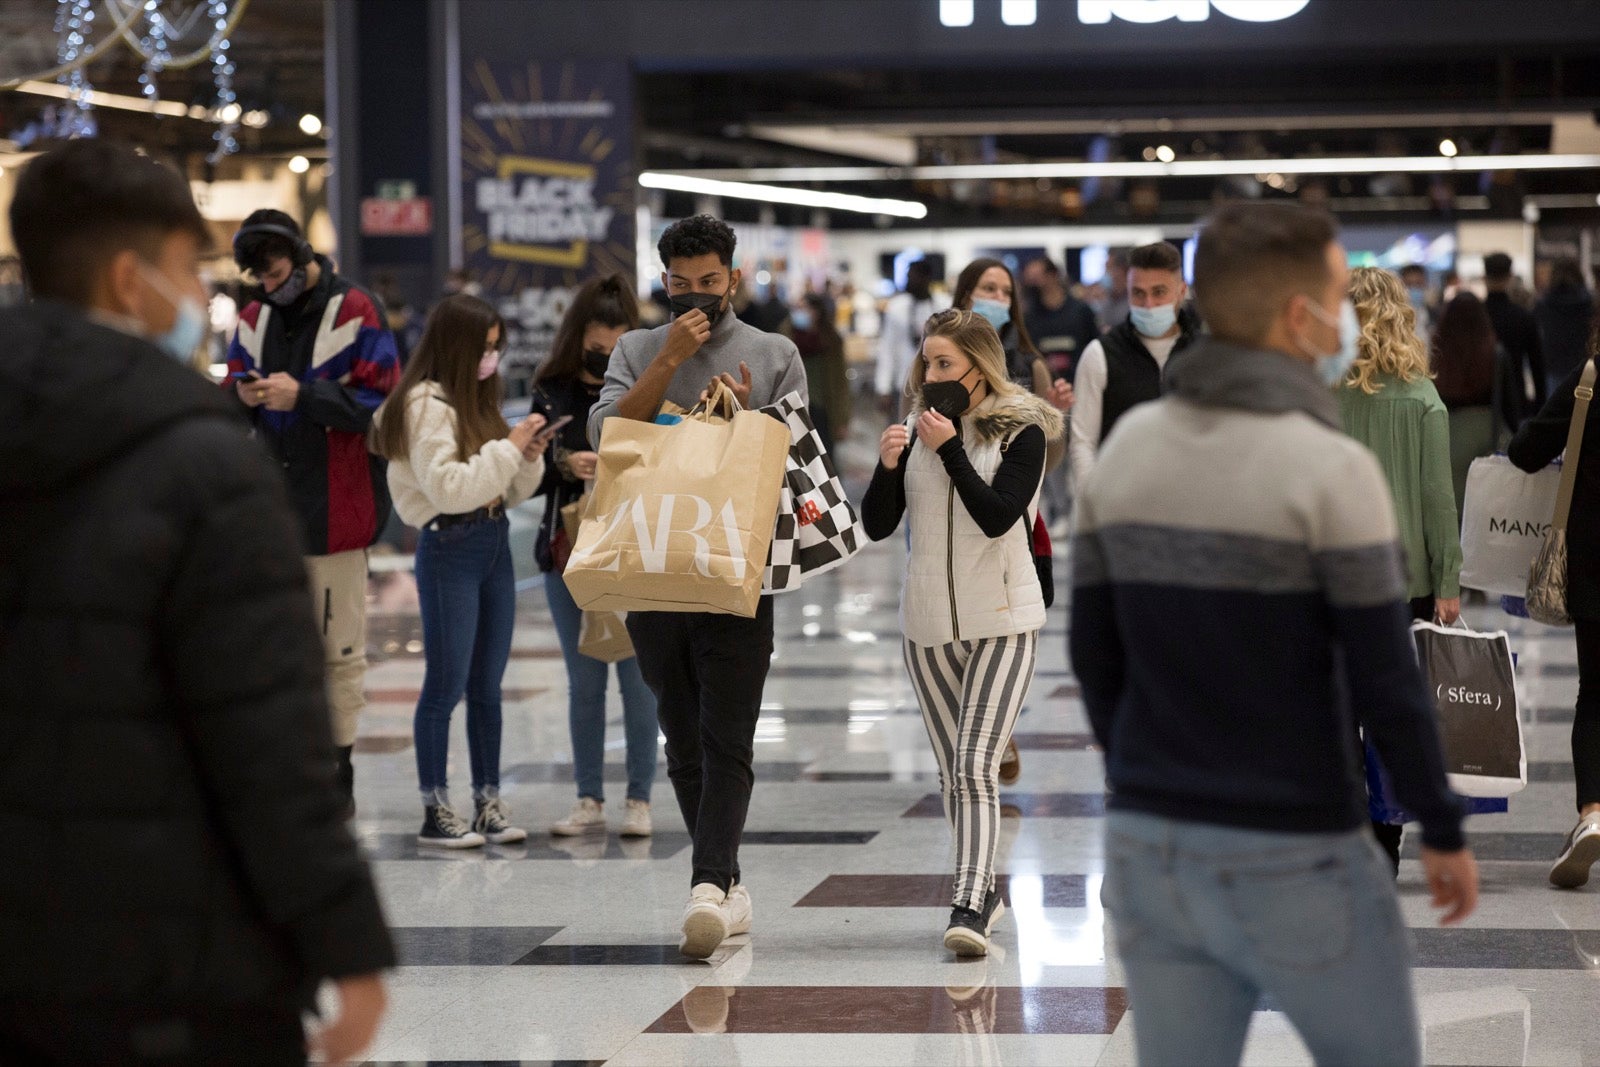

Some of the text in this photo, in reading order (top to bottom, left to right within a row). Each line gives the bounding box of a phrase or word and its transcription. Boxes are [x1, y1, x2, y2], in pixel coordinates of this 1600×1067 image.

[477, 178, 595, 212] BLACK
[490, 207, 614, 241] FRIDAY
[563, 493, 747, 579] ZARA
